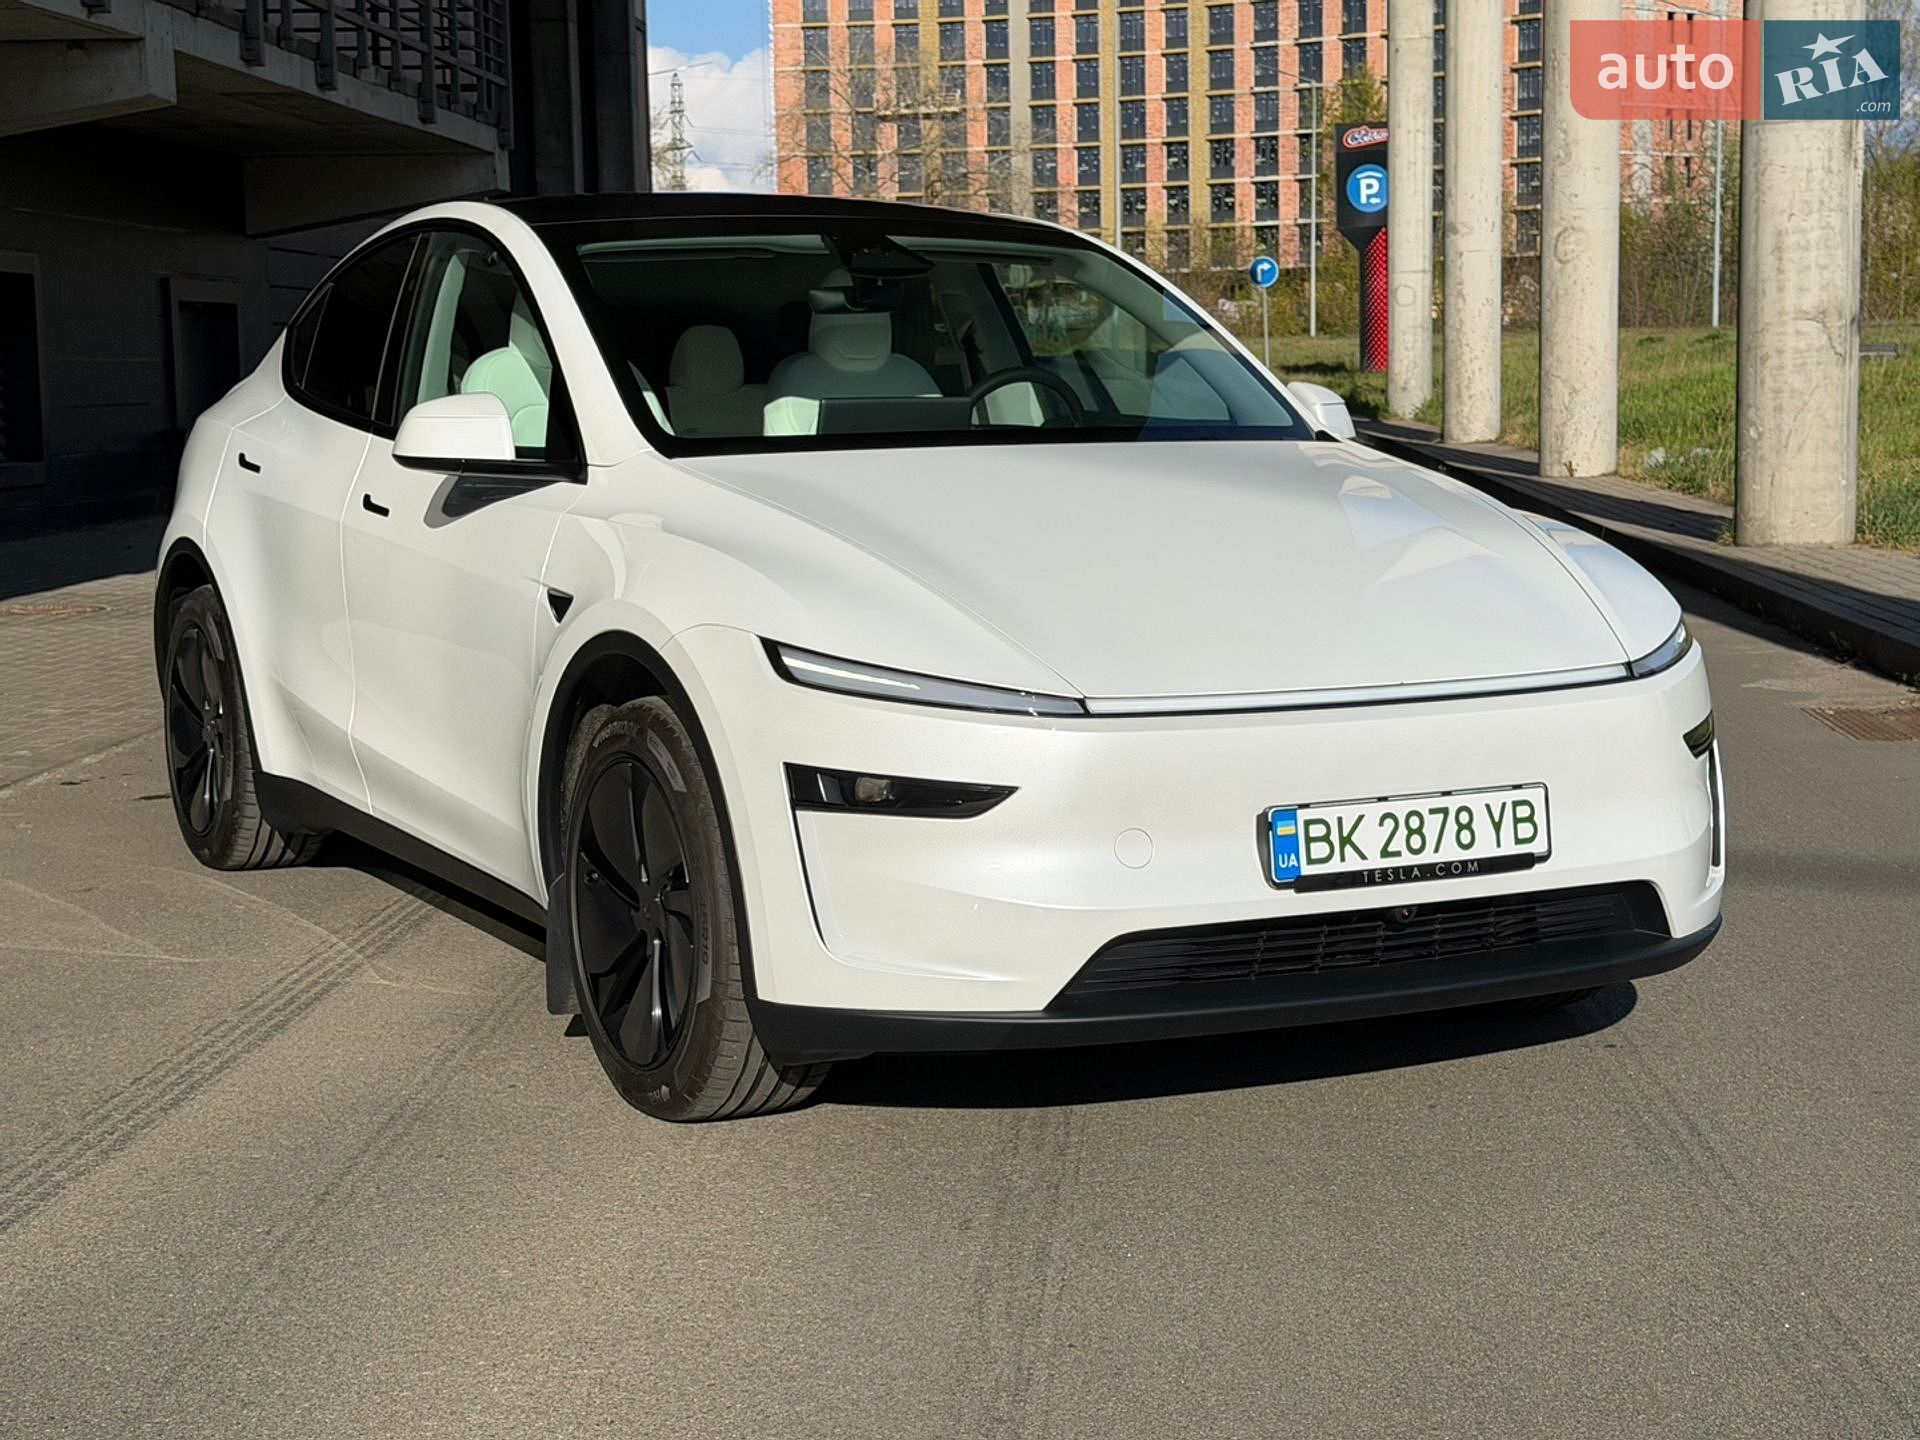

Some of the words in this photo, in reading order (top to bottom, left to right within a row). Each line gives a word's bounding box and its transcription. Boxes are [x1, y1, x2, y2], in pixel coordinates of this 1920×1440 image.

[1303, 813, 1369, 866] BK
[1378, 804, 1476, 859] 2878
[1485, 799, 1539, 848] YB
[1278, 852, 1299, 868] UA
[1361, 861, 1480, 884] TESLA.COM
